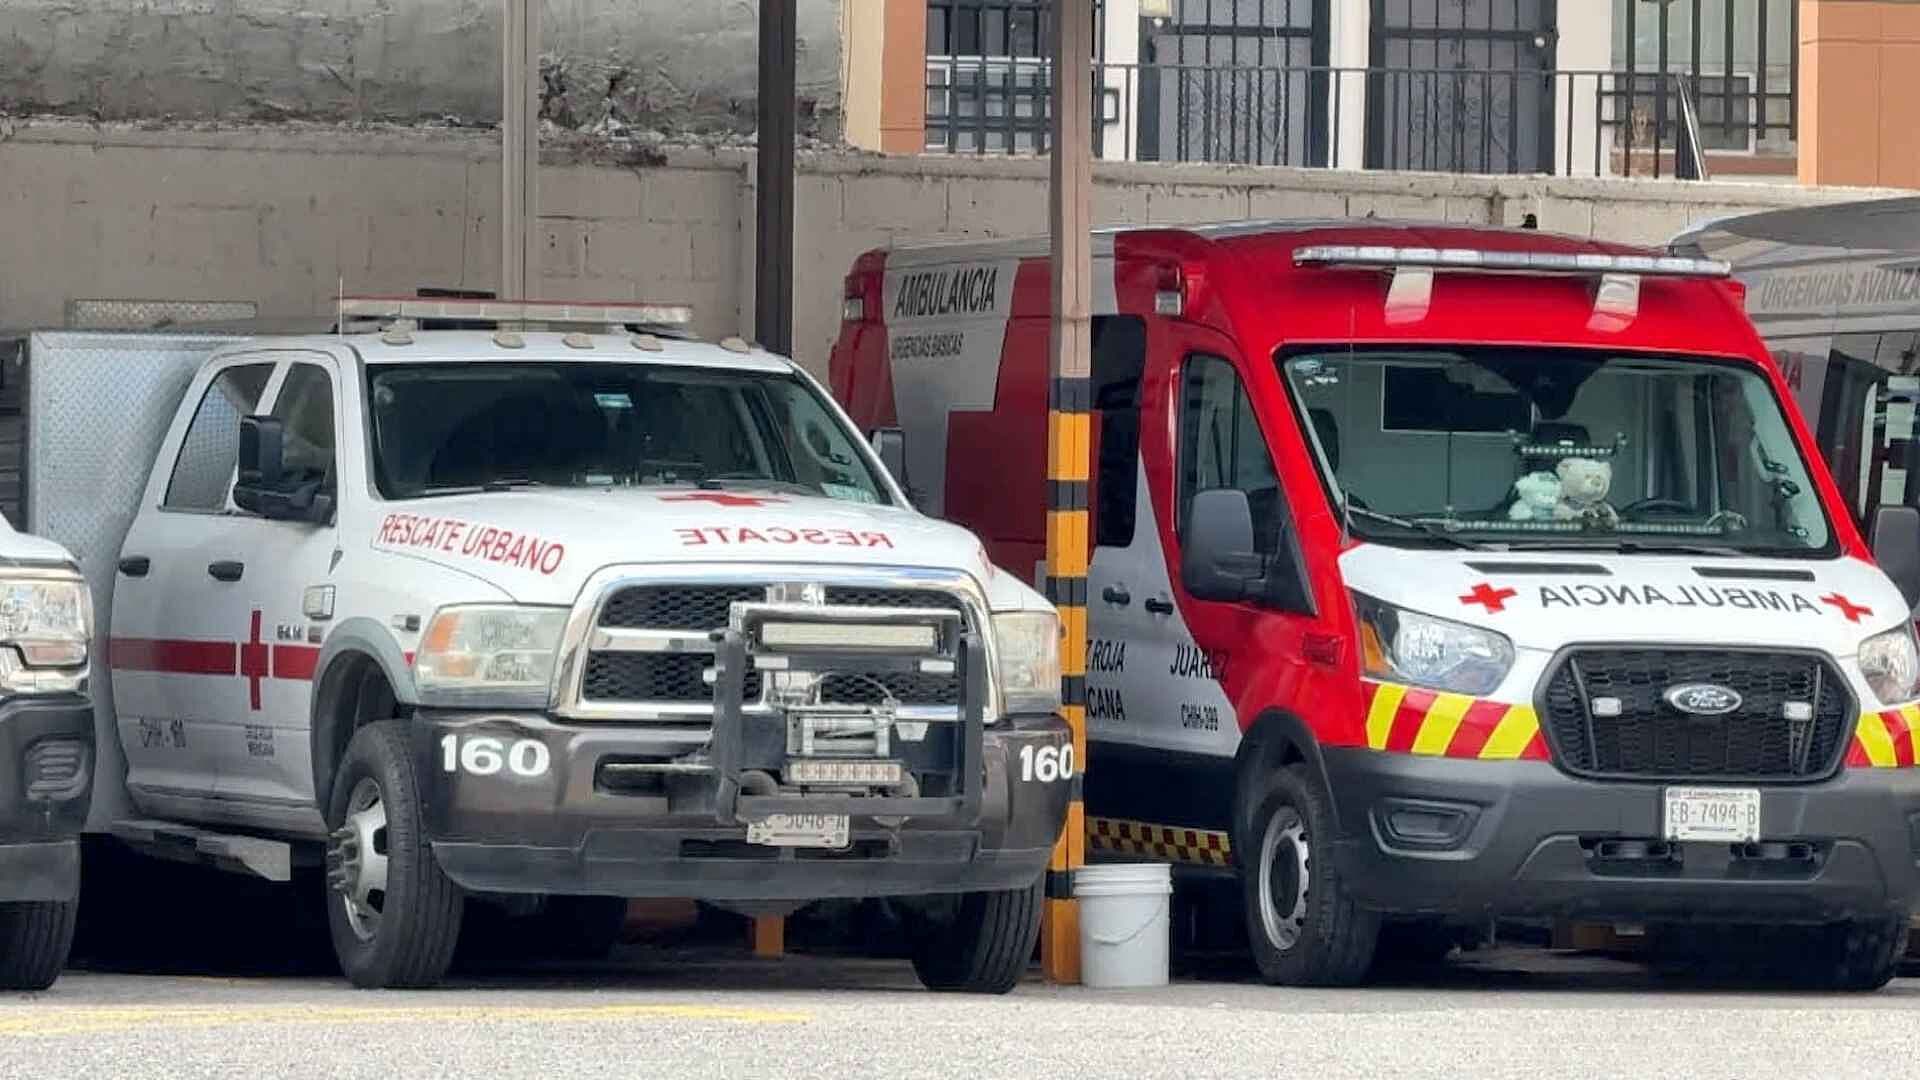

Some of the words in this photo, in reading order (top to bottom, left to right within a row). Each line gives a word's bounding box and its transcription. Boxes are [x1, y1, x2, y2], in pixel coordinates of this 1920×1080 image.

[895, 267, 998, 318] AMBULANCIA
[1761, 272, 1853, 310] URGENCIAS
[378, 514, 465, 550] RESCATE
[462, 525, 565, 575] URBANO
[1092, 640, 1126, 673] ROJA
[1170, 642, 1229, 682] JUAREZ
[440, 734, 551, 776] 160
[1020, 743, 1074, 782] 160
